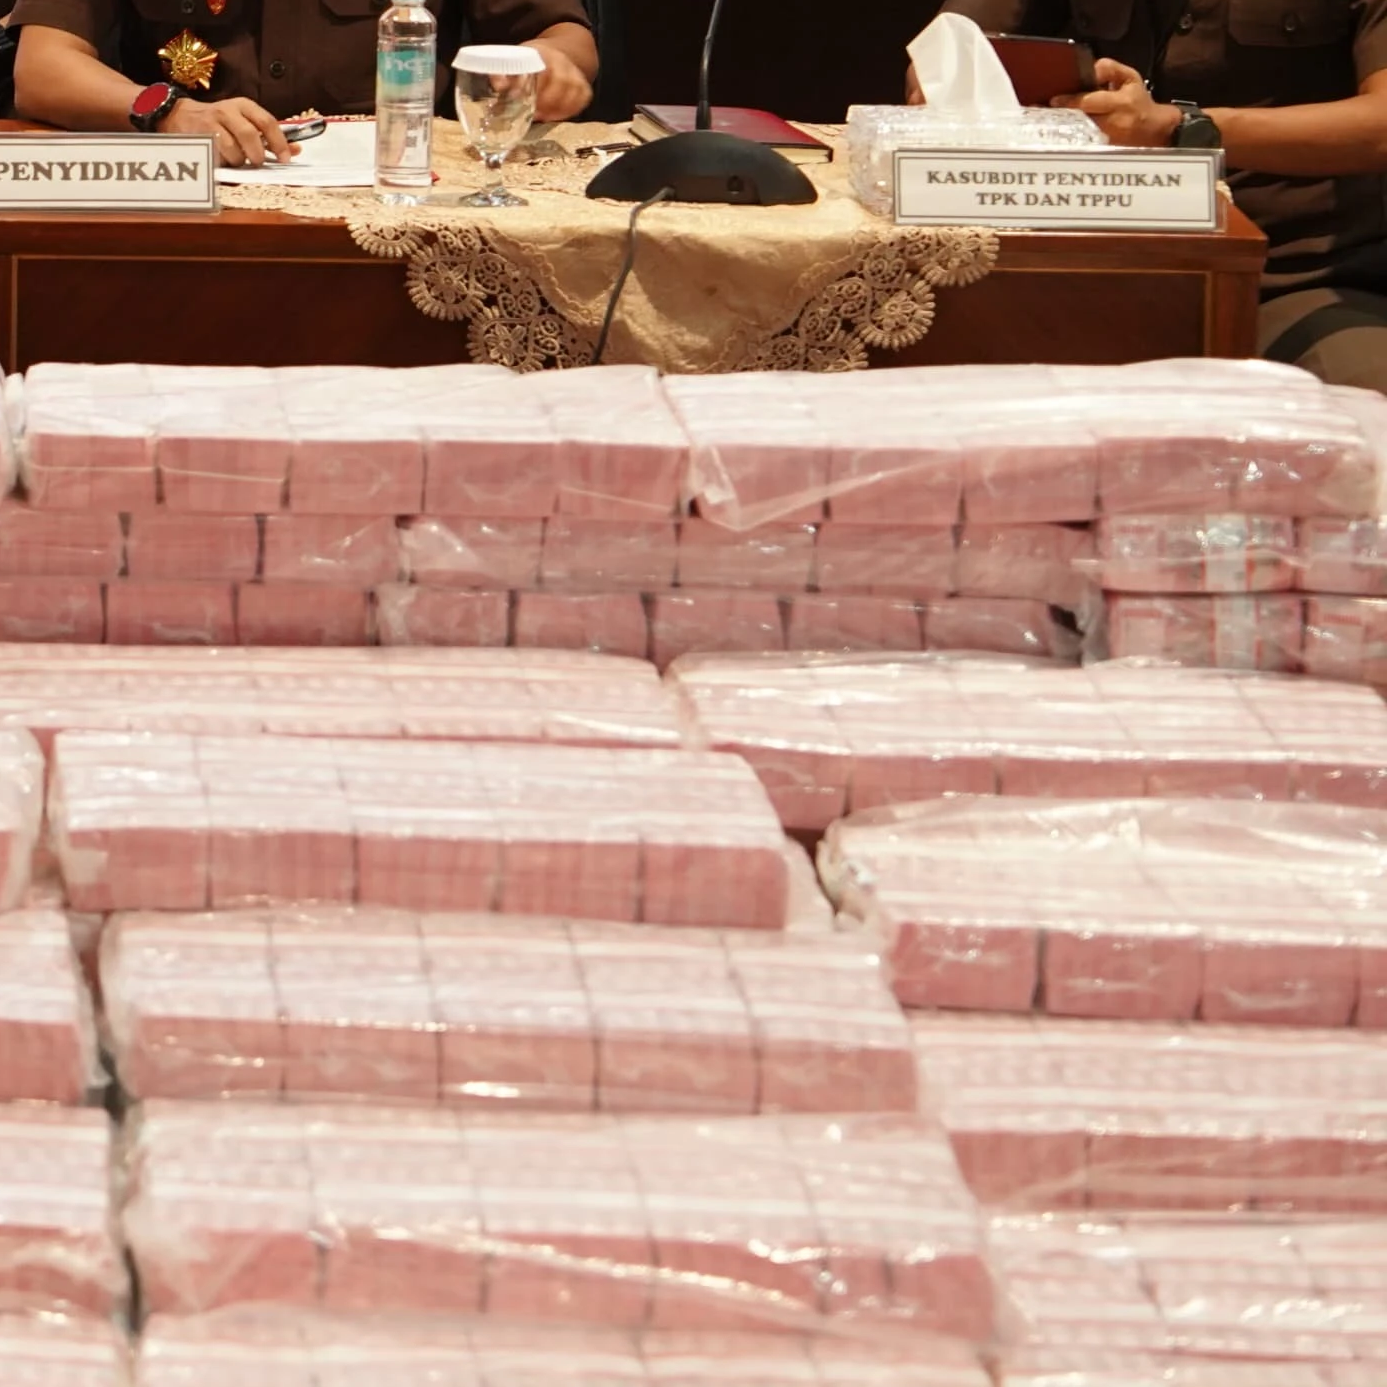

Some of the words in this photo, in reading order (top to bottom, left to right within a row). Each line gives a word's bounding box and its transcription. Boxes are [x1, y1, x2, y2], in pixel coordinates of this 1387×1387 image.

[926, 171, 1038, 185] KASUBDIT
[1044, 173, 1182, 187] PENYIDIKAN
[975, 192, 1019, 206] TPK
[1026, 193, 1071, 206] DAN
[1076, 194, 1133, 207] TPPU
